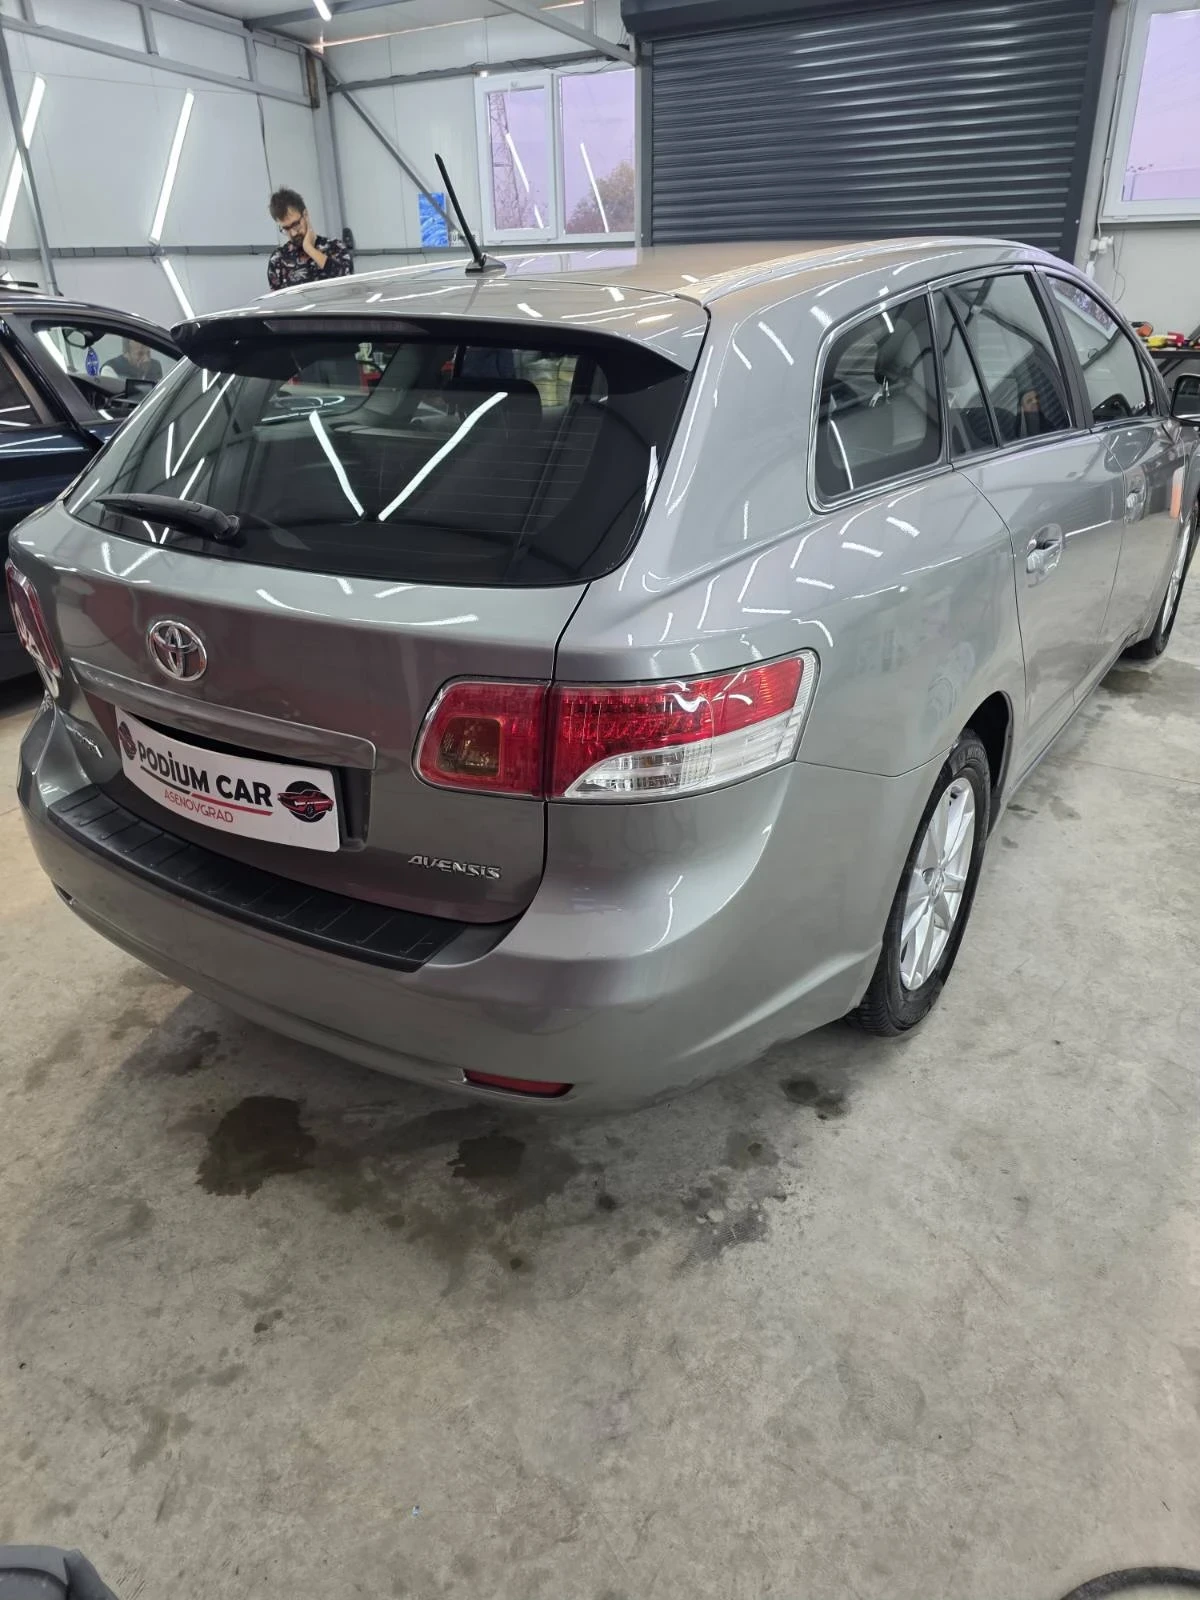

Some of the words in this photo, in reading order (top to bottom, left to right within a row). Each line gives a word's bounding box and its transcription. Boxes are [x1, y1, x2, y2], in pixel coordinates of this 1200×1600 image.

[164, 789, 234, 823] ASENOVGRAD
[215, 774, 273, 807] CAR
[407, 855, 501, 880] AVENSIS
